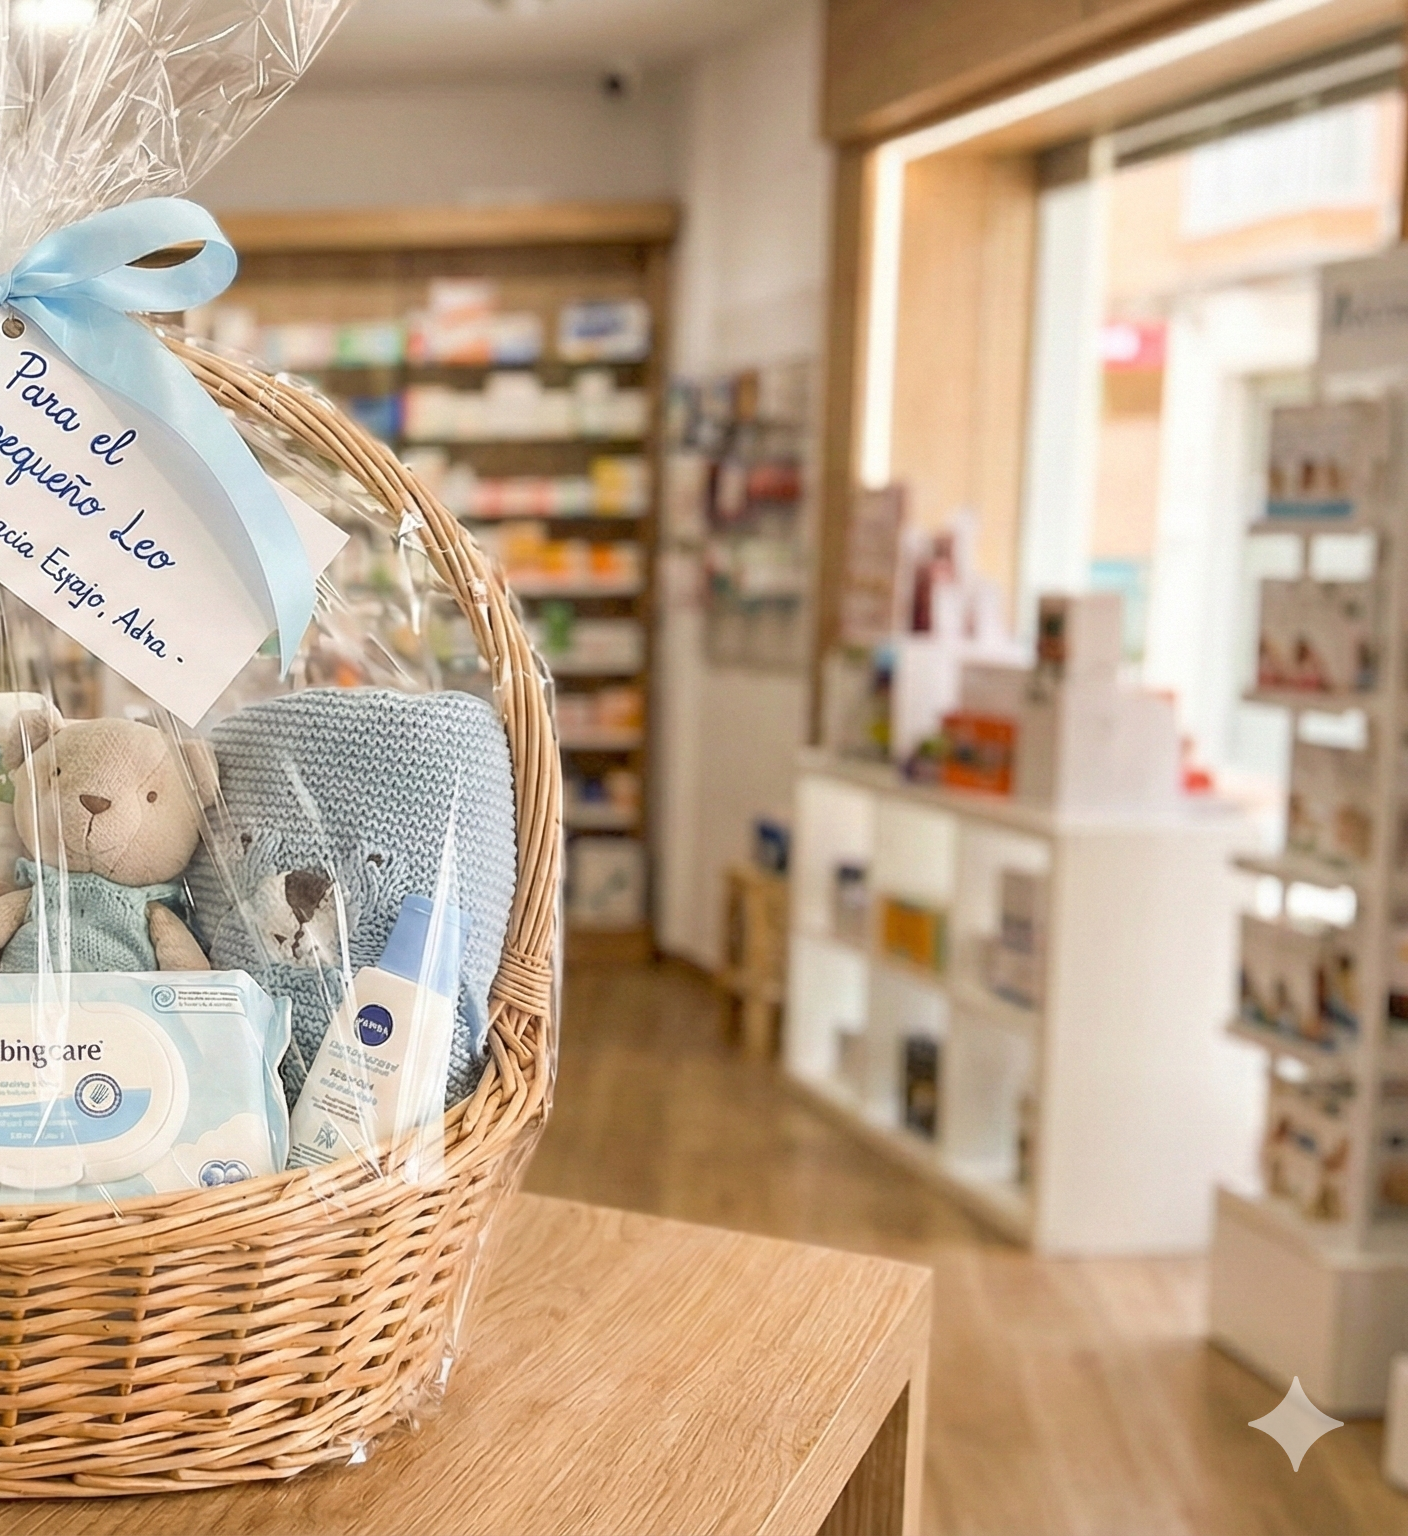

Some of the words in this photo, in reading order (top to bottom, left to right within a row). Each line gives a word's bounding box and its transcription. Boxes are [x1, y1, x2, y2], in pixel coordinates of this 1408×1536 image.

[4, 350, 82, 433] Para
[90, 429, 137, 466] el
[109, 509, 176, 570] Leo
[111, 607, 167, 658] Adra
